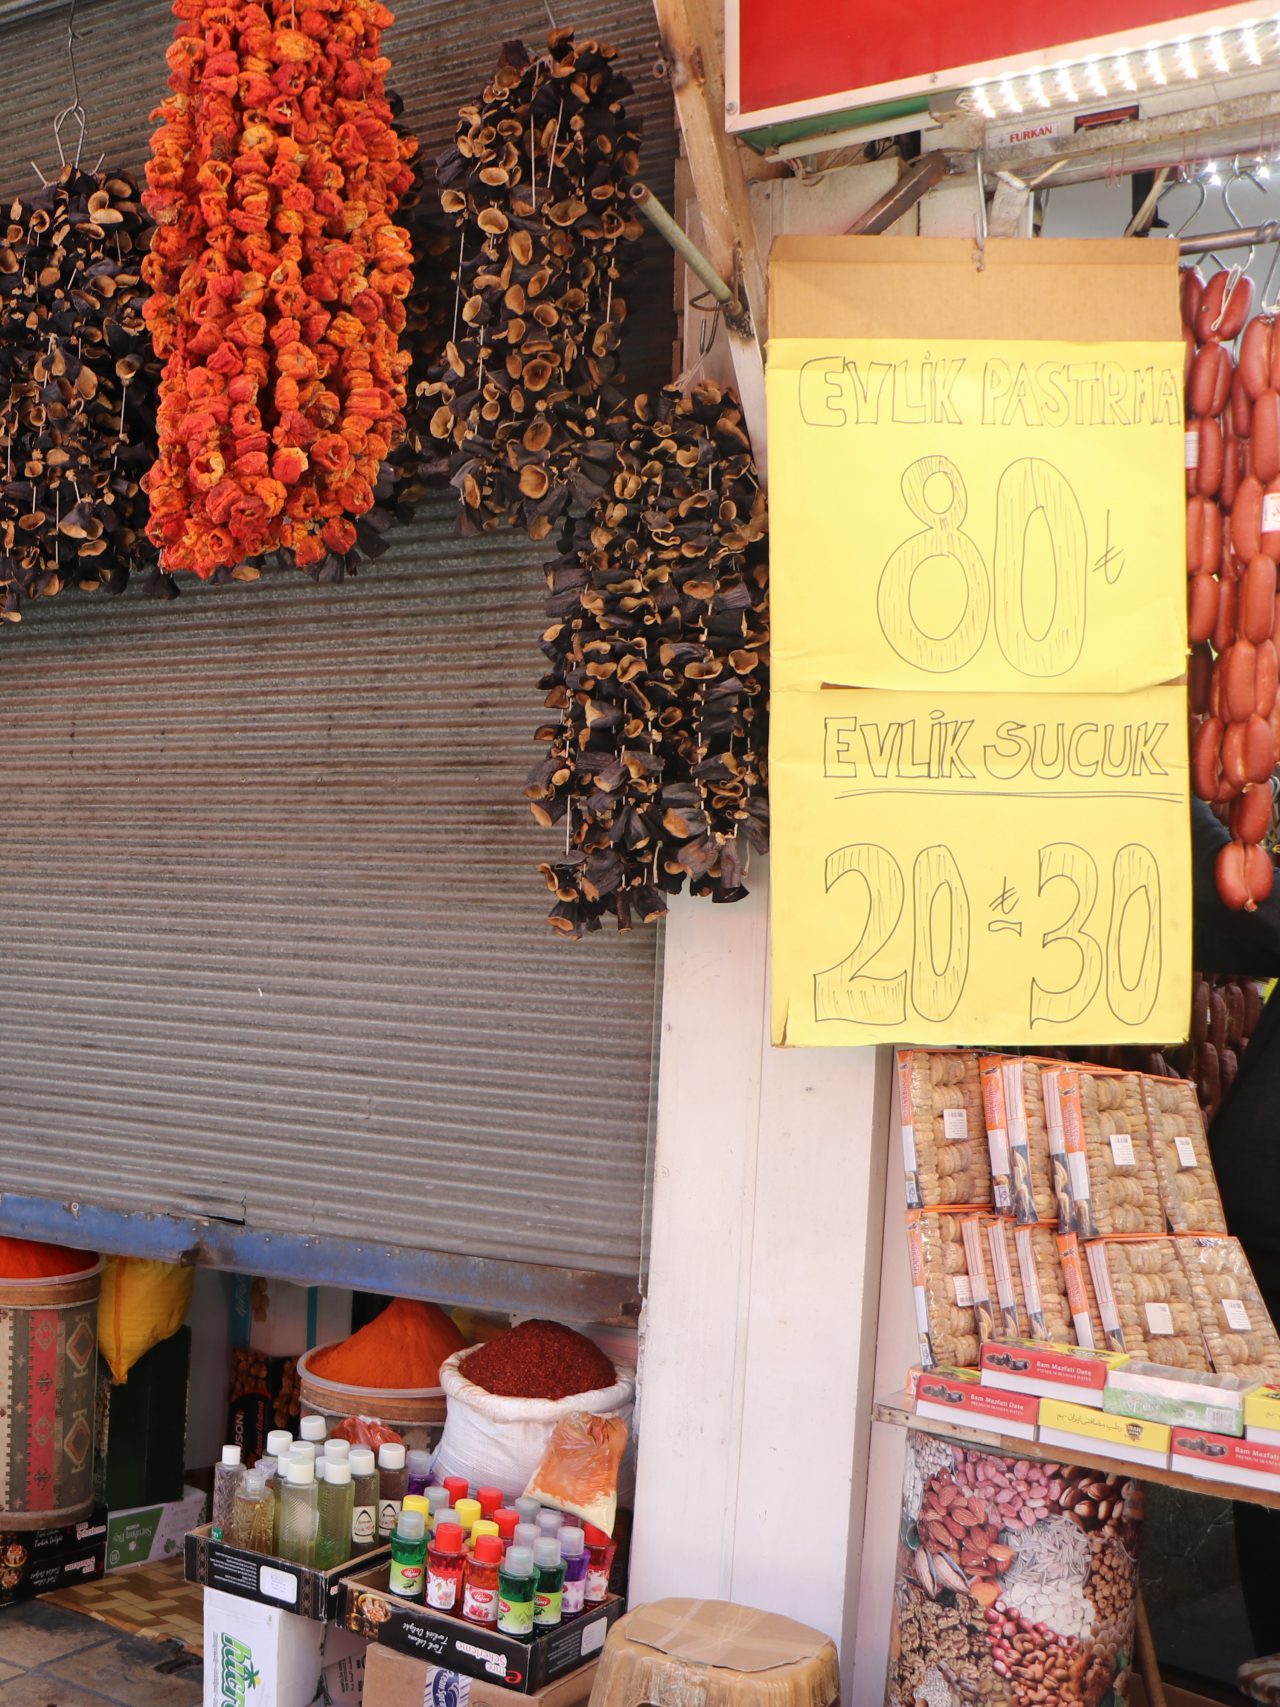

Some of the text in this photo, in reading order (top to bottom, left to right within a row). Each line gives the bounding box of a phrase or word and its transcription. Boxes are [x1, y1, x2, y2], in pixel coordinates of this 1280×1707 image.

[1009, 125, 1053, 143] FURKAN
[799, 351, 1182, 429] EVLİK PASTIRMA
[876, 455, 1088, 678] 80
[823, 709, 1169, 780] EVLİK SUCUK
[813, 842, 971, 1026] 20
[1030, 841, 1163, 1030] 30
[1036, 1361, 1092, 1377] Bam Mazfati Date
[970, 1394, 1024, 1411] Bam Mazfati Date
[1234, 1446, 1250, 1456] Bam
[402, 1622, 425, 1637] Delight
[435, 1689, 447, 1707] Spra
